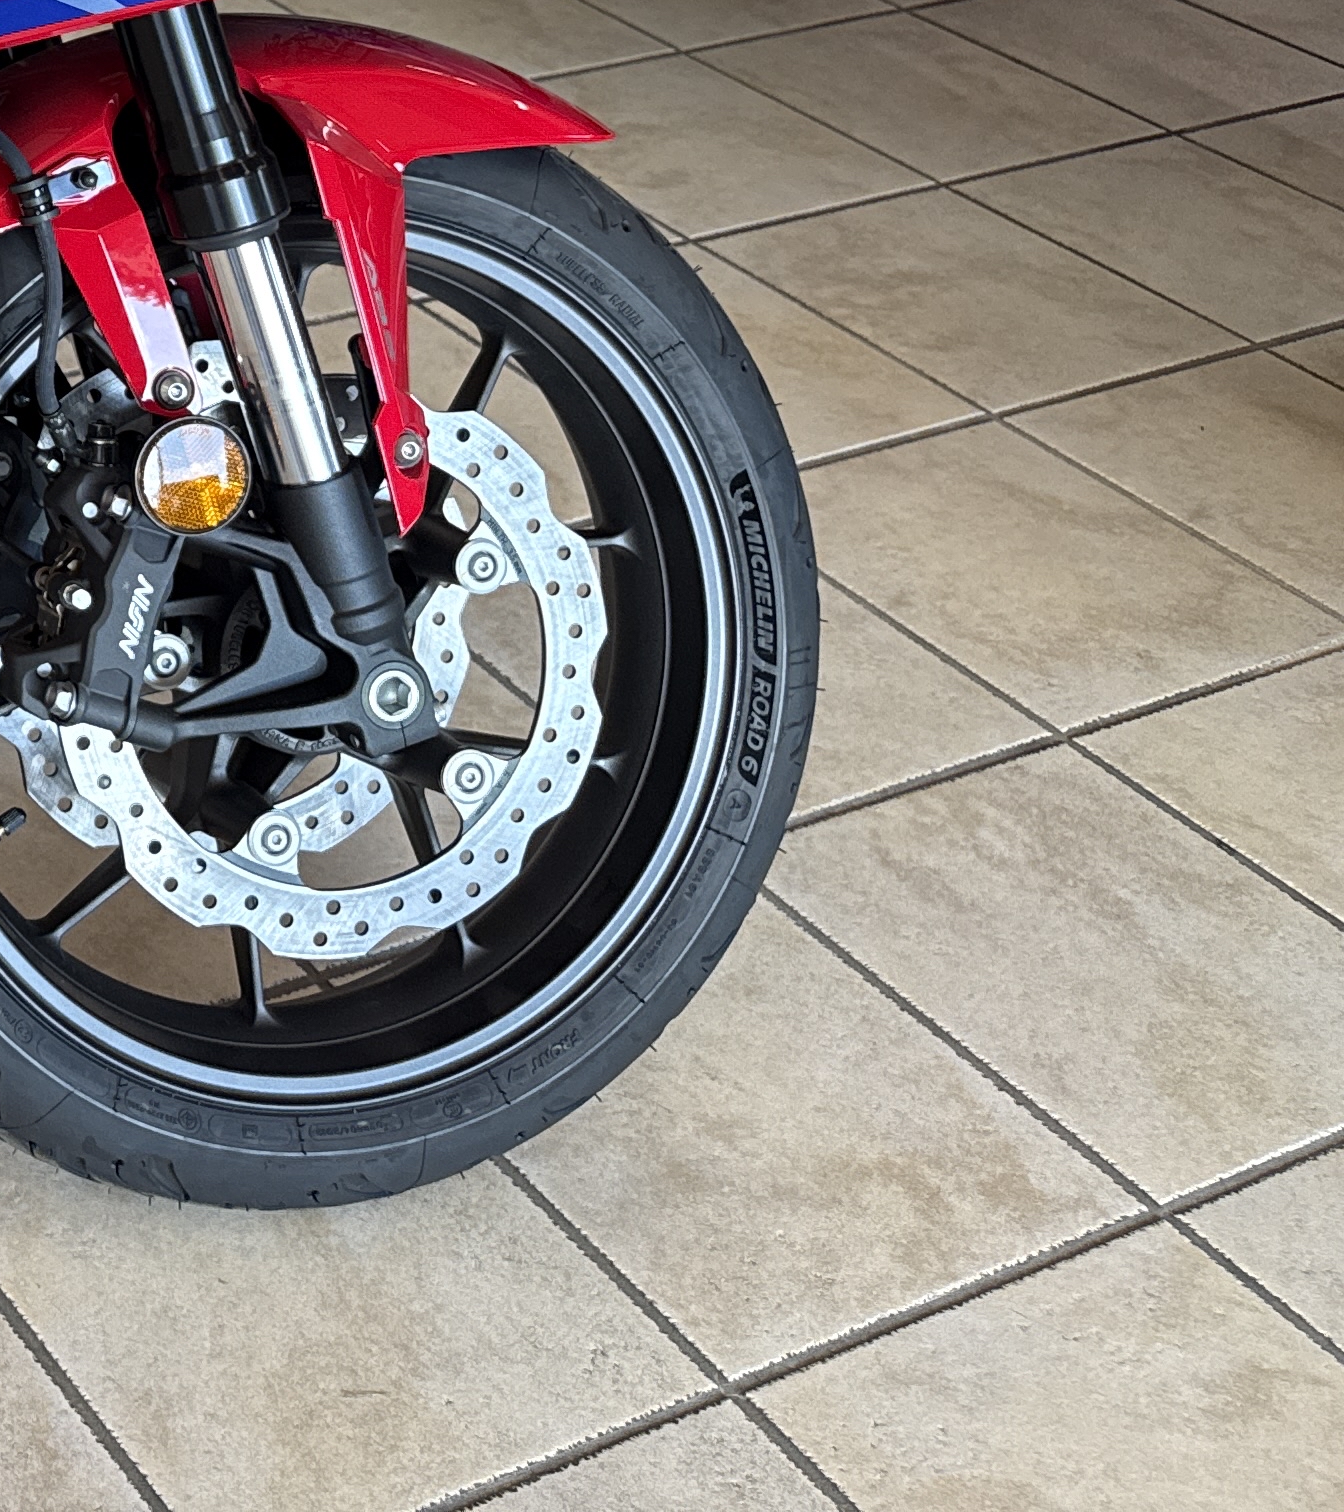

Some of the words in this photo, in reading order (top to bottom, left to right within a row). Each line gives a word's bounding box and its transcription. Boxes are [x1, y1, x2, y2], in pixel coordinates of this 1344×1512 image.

[742, 519, 776, 655] MICHELIN
[746, 679, 773, 751] ROAD
[740, 754, 758, 778] 6
